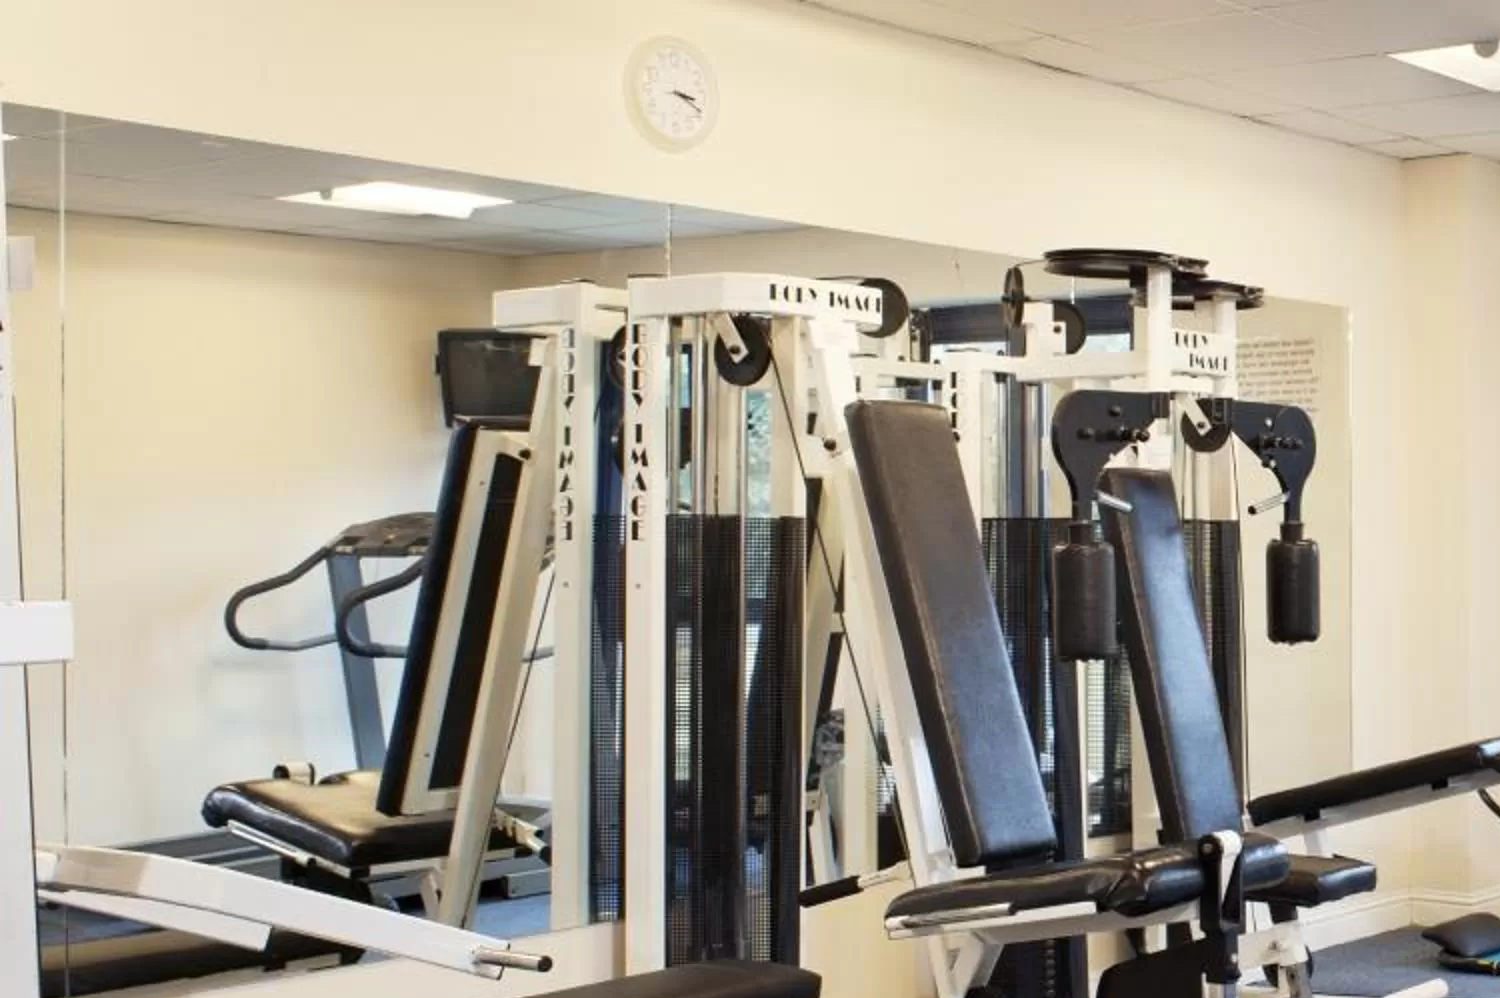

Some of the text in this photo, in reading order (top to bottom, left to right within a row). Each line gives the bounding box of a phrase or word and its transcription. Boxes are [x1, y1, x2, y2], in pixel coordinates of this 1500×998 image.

[769, 283, 883, 313] BODY IMAGE
[631, 323, 650, 541] BODY IMAGE
